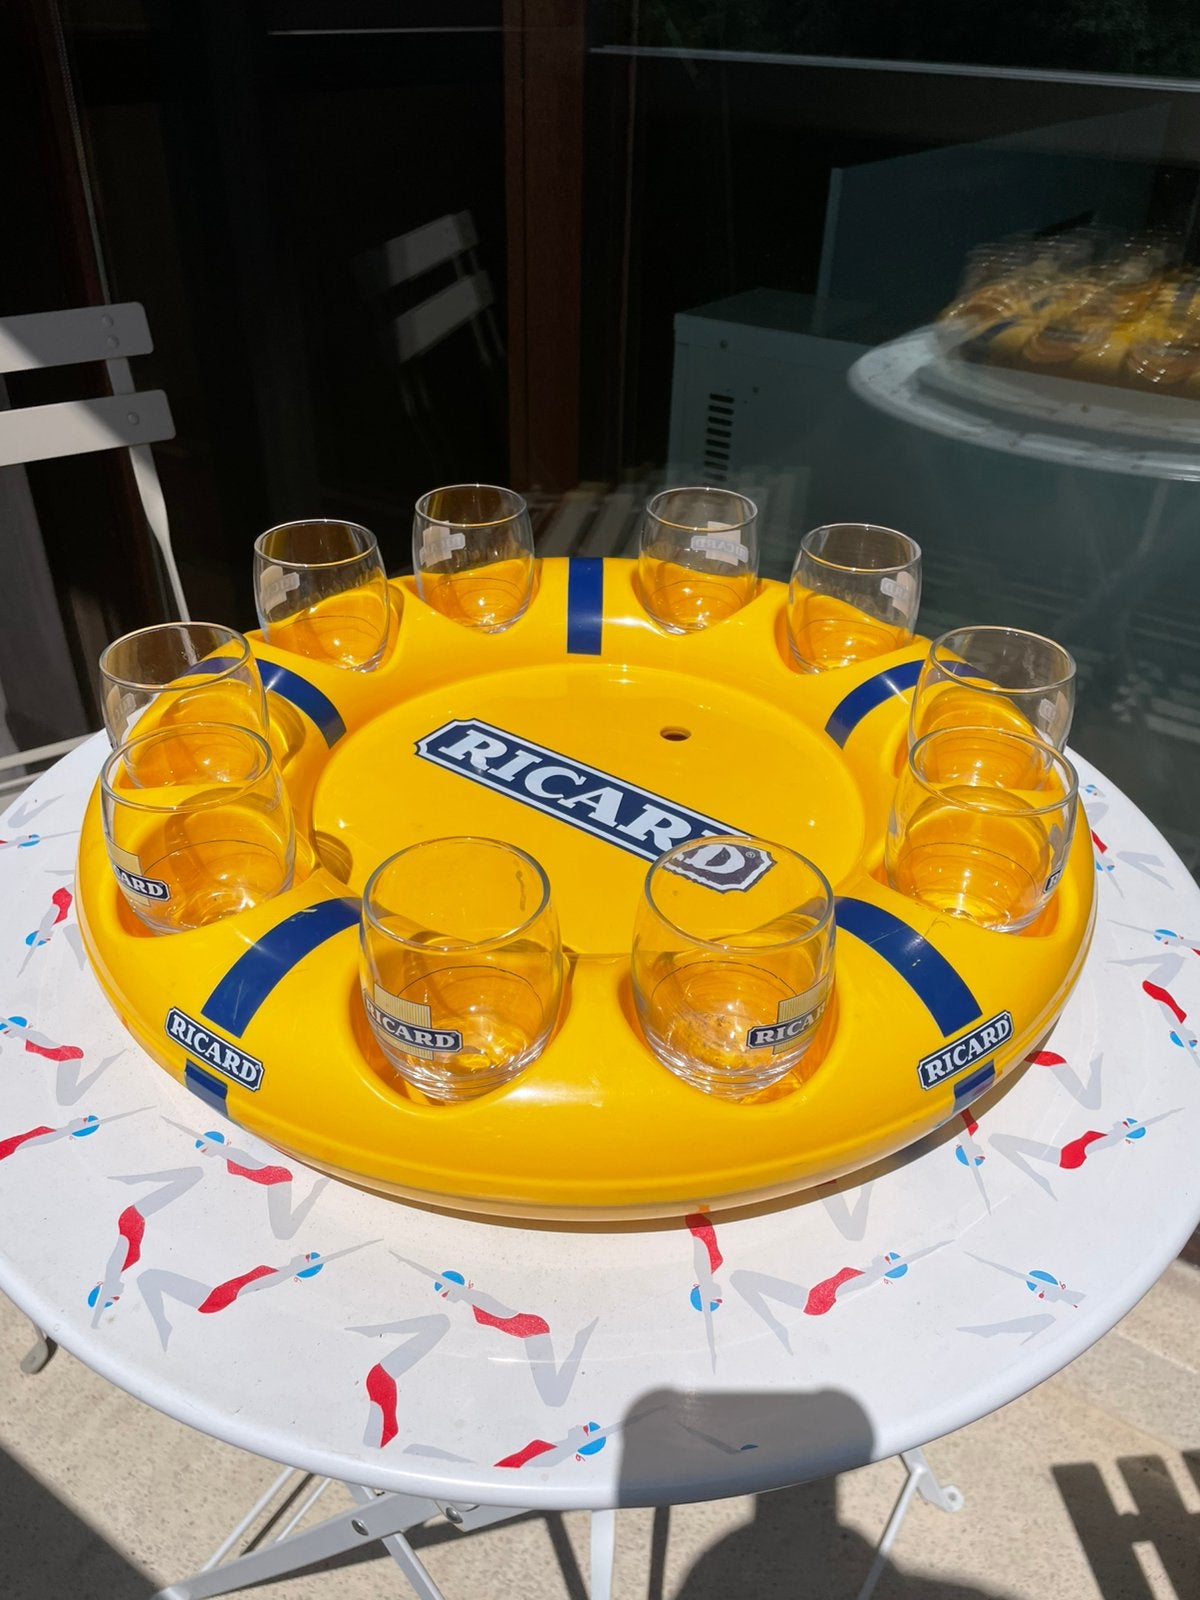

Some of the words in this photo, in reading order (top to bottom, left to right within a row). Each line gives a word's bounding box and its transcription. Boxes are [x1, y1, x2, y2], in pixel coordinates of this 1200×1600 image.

[438, 729, 746, 875] RICARD
[170, 1014, 258, 1084] RICARD
[366, 1001, 456, 1049] RICARD
[924, 1019, 1010, 1083] RICARD
